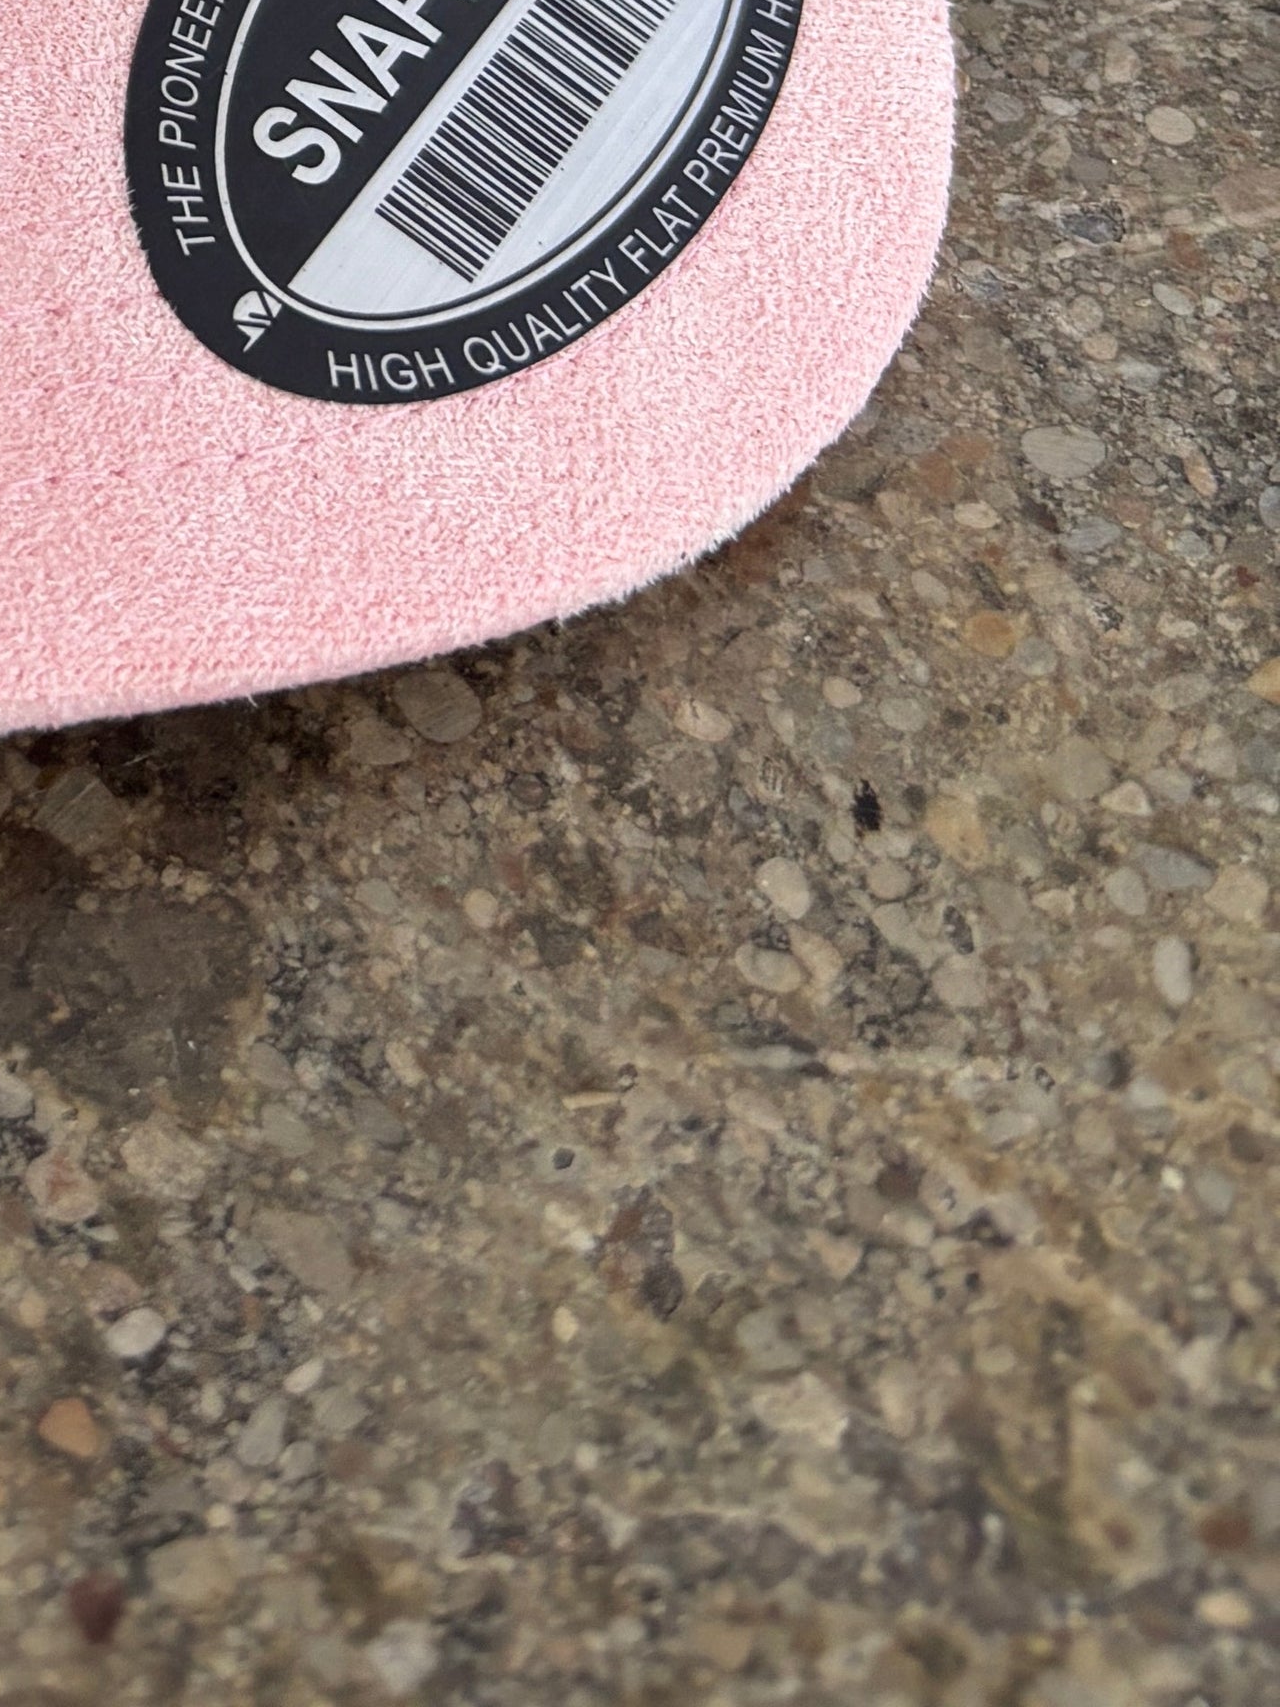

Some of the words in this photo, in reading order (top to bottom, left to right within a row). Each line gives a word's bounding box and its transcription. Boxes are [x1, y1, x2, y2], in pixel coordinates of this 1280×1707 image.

[163, 163, 215, 255] THE
[328, 349, 454, 391] HIGH
[463, 258, 629, 375] QUALITY
[618, 185, 700, 275] FLAT
[683, 29, 785, 198] PREMIUM
